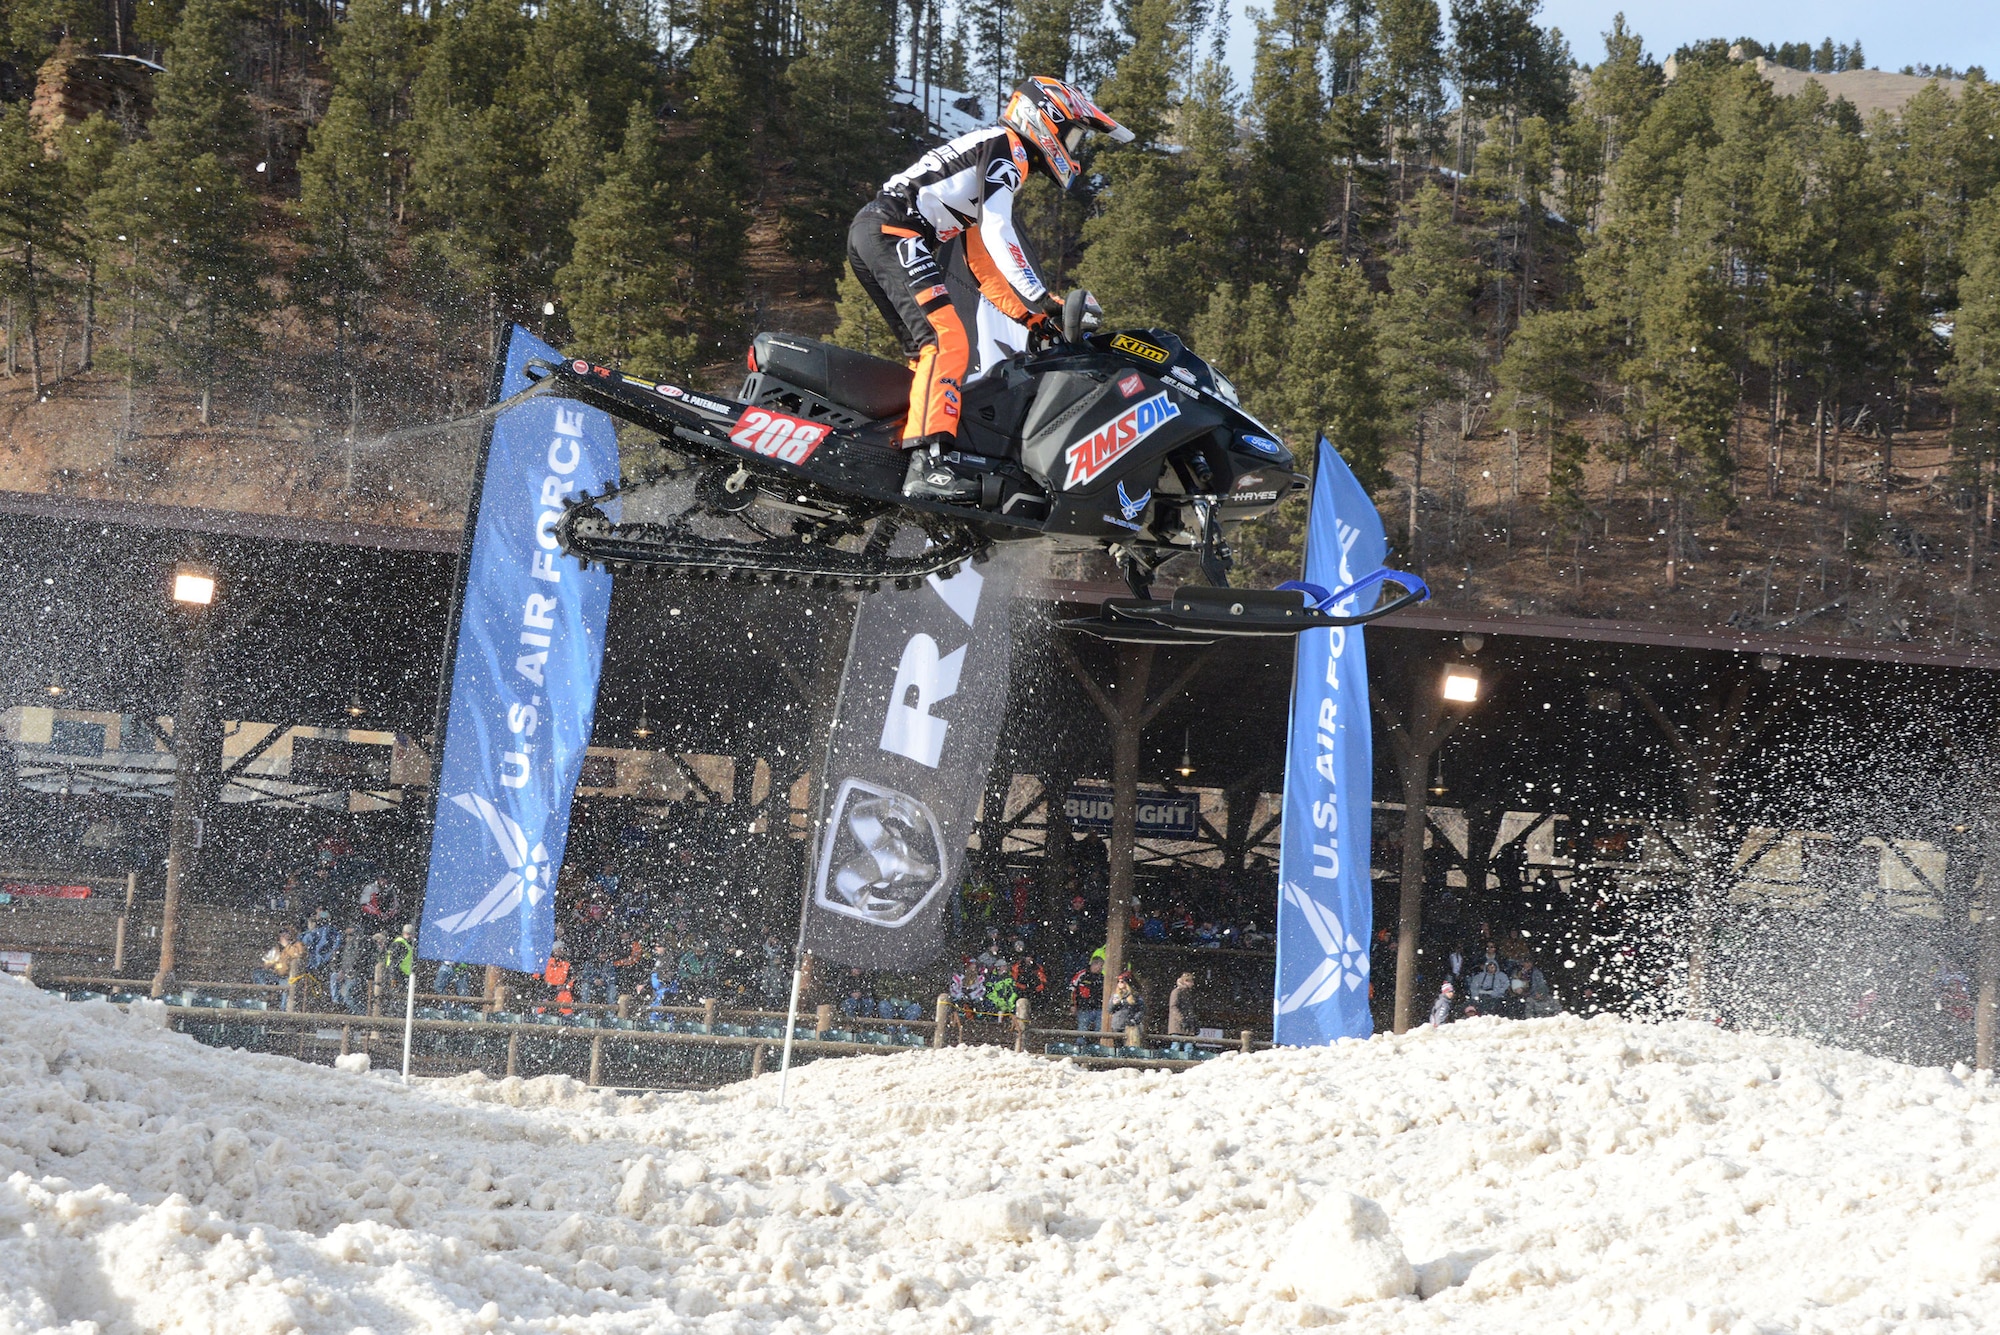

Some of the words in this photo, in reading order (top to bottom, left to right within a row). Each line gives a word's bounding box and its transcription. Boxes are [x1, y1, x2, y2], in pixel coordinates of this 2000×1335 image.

[1115, 335, 1164, 362] Klim
[730, 412, 824, 464] 208
[1068, 394, 1179, 484] AMSOIL
[531, 405, 584, 583] FORCE
[1231, 490, 1278, 502] HAYES
[515, 593, 557, 688] AIR
[500, 695, 541, 789] U.S.
[1316, 697, 1338, 785] AIR
[1065, 798, 1114, 820] BUD
[1134, 803, 1190, 825] IGHT
[1313, 793, 1339, 879] U.S.
